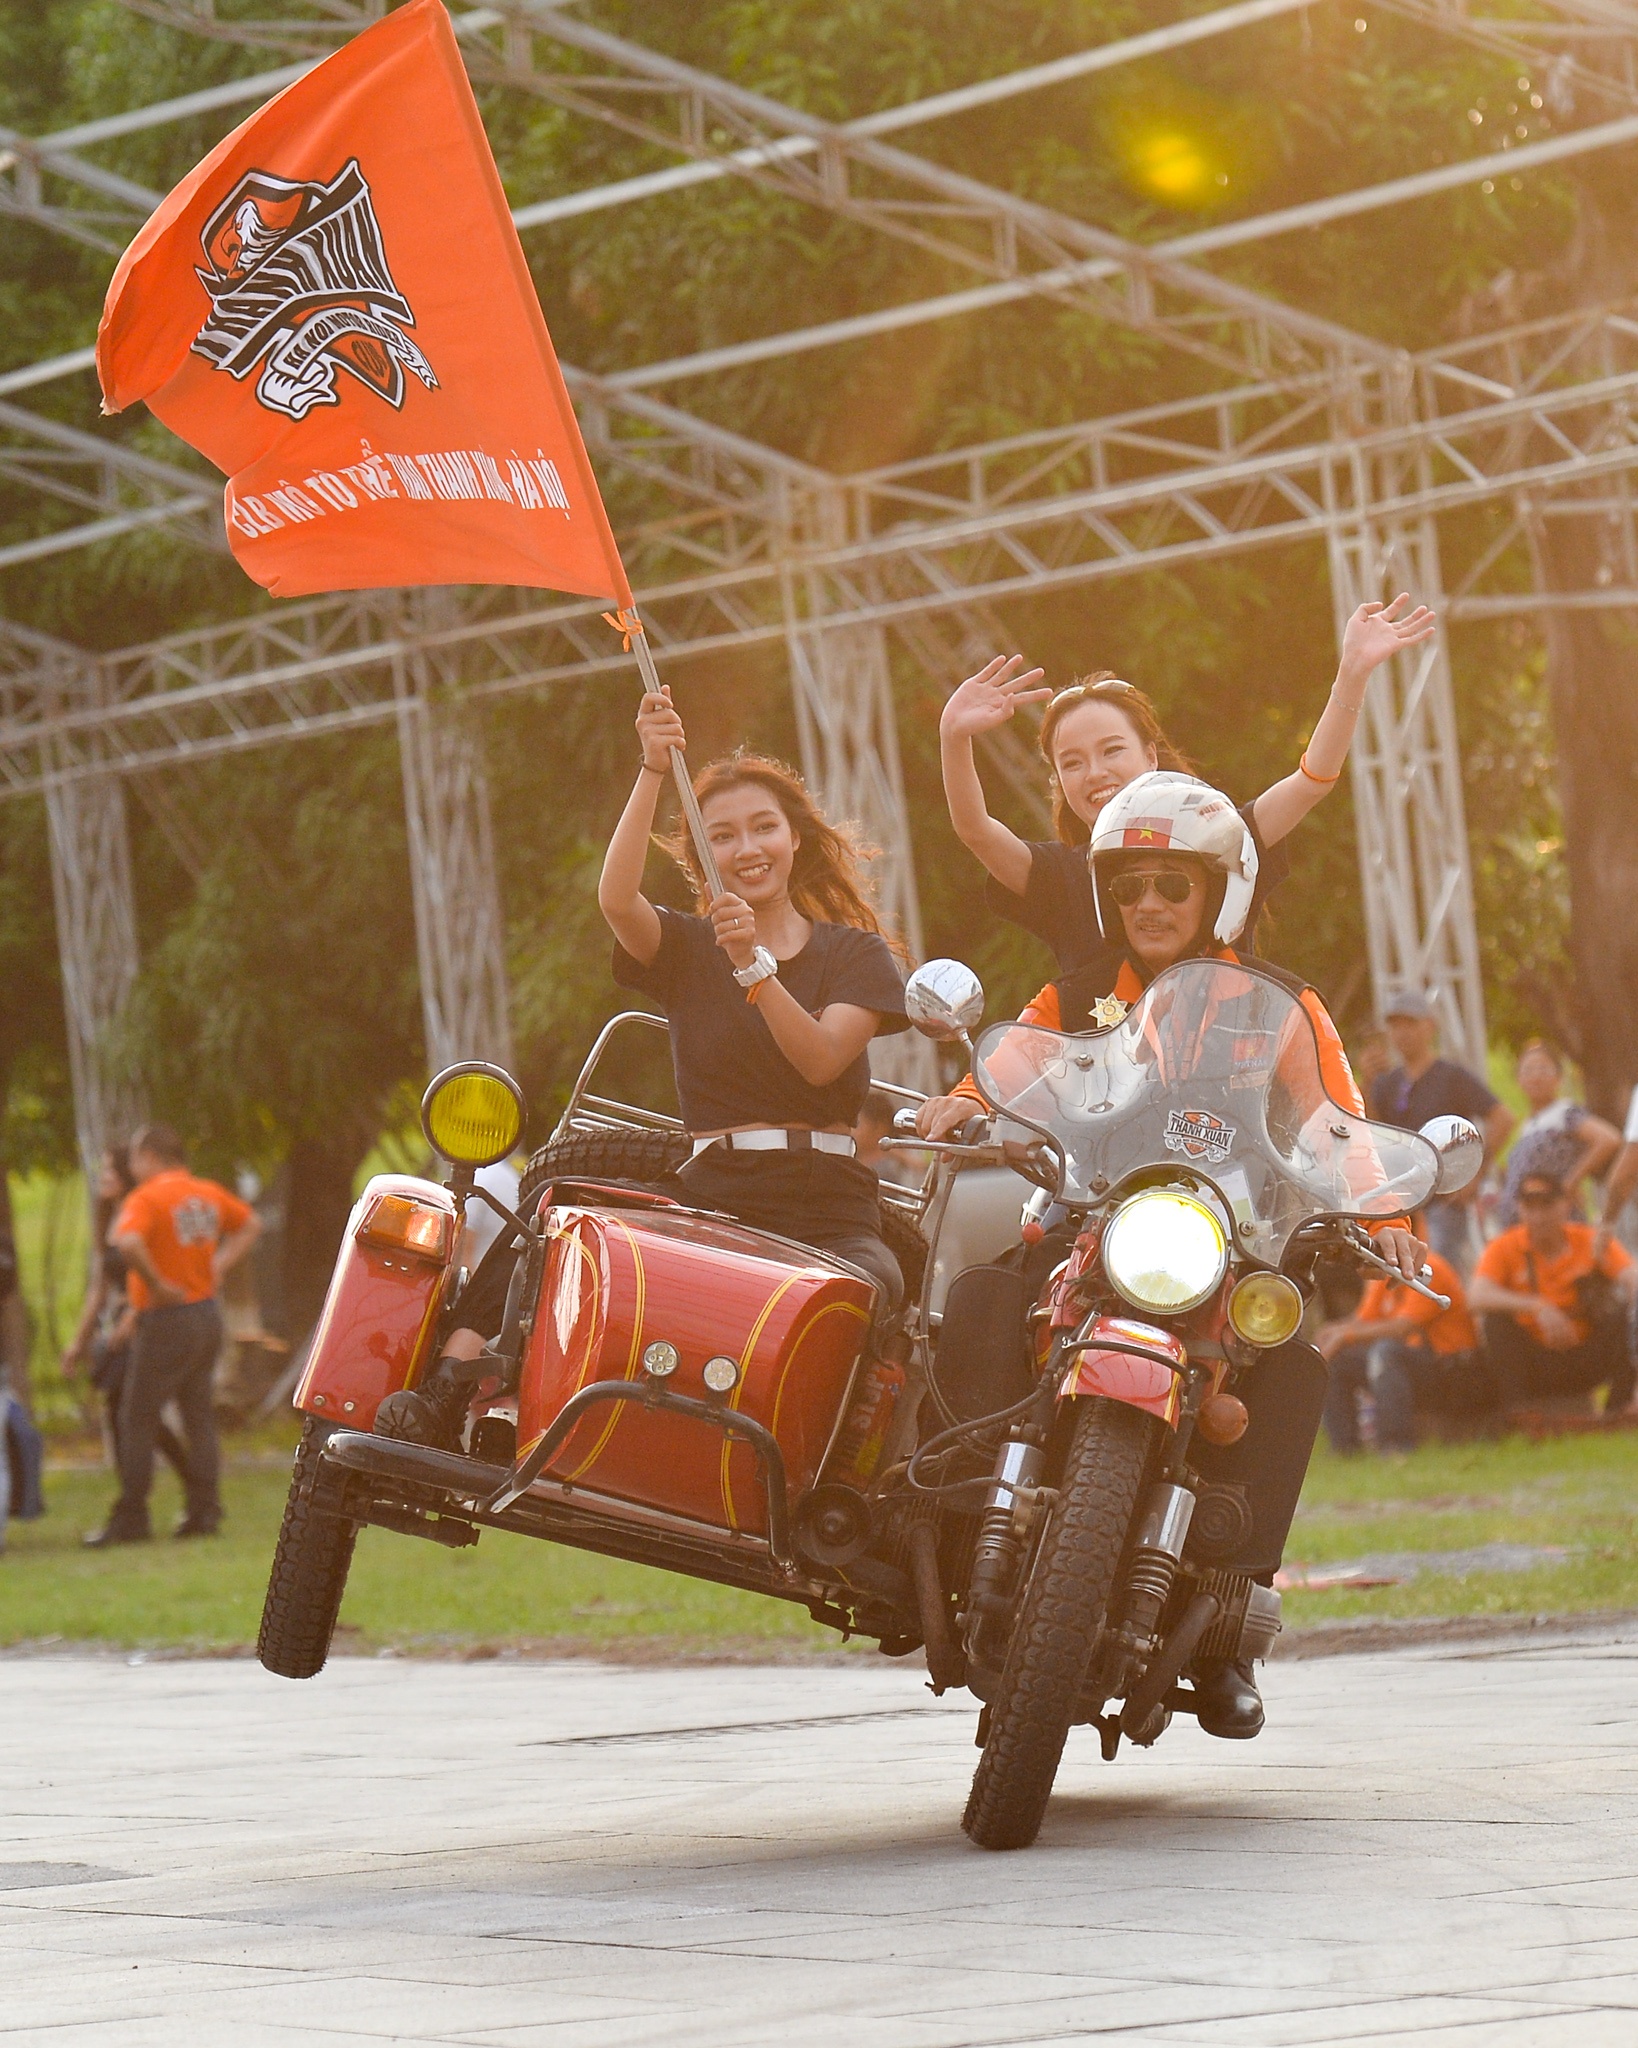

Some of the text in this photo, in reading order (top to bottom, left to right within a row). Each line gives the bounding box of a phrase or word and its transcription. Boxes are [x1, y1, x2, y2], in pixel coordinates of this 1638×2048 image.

[283, 343, 312, 370] HA
[304, 320, 335, 349] NOI
[325, 311, 367, 332] MOTOR
[232, 496, 286, 538] CLB
[262, 479, 326, 524] MÔ
[303, 468, 359, 512] TÔ
[337, 438, 400, 501] THỂ
[384, 453, 434, 500] THAO
[415, 450, 484, 500] THANH
[505, 449, 544, 509] HÀ
[528, 448, 571, 520] NỘI
[1170, 1117, 1202, 1137] THANH
[1203, 1129, 1231, 1147] XUAN
